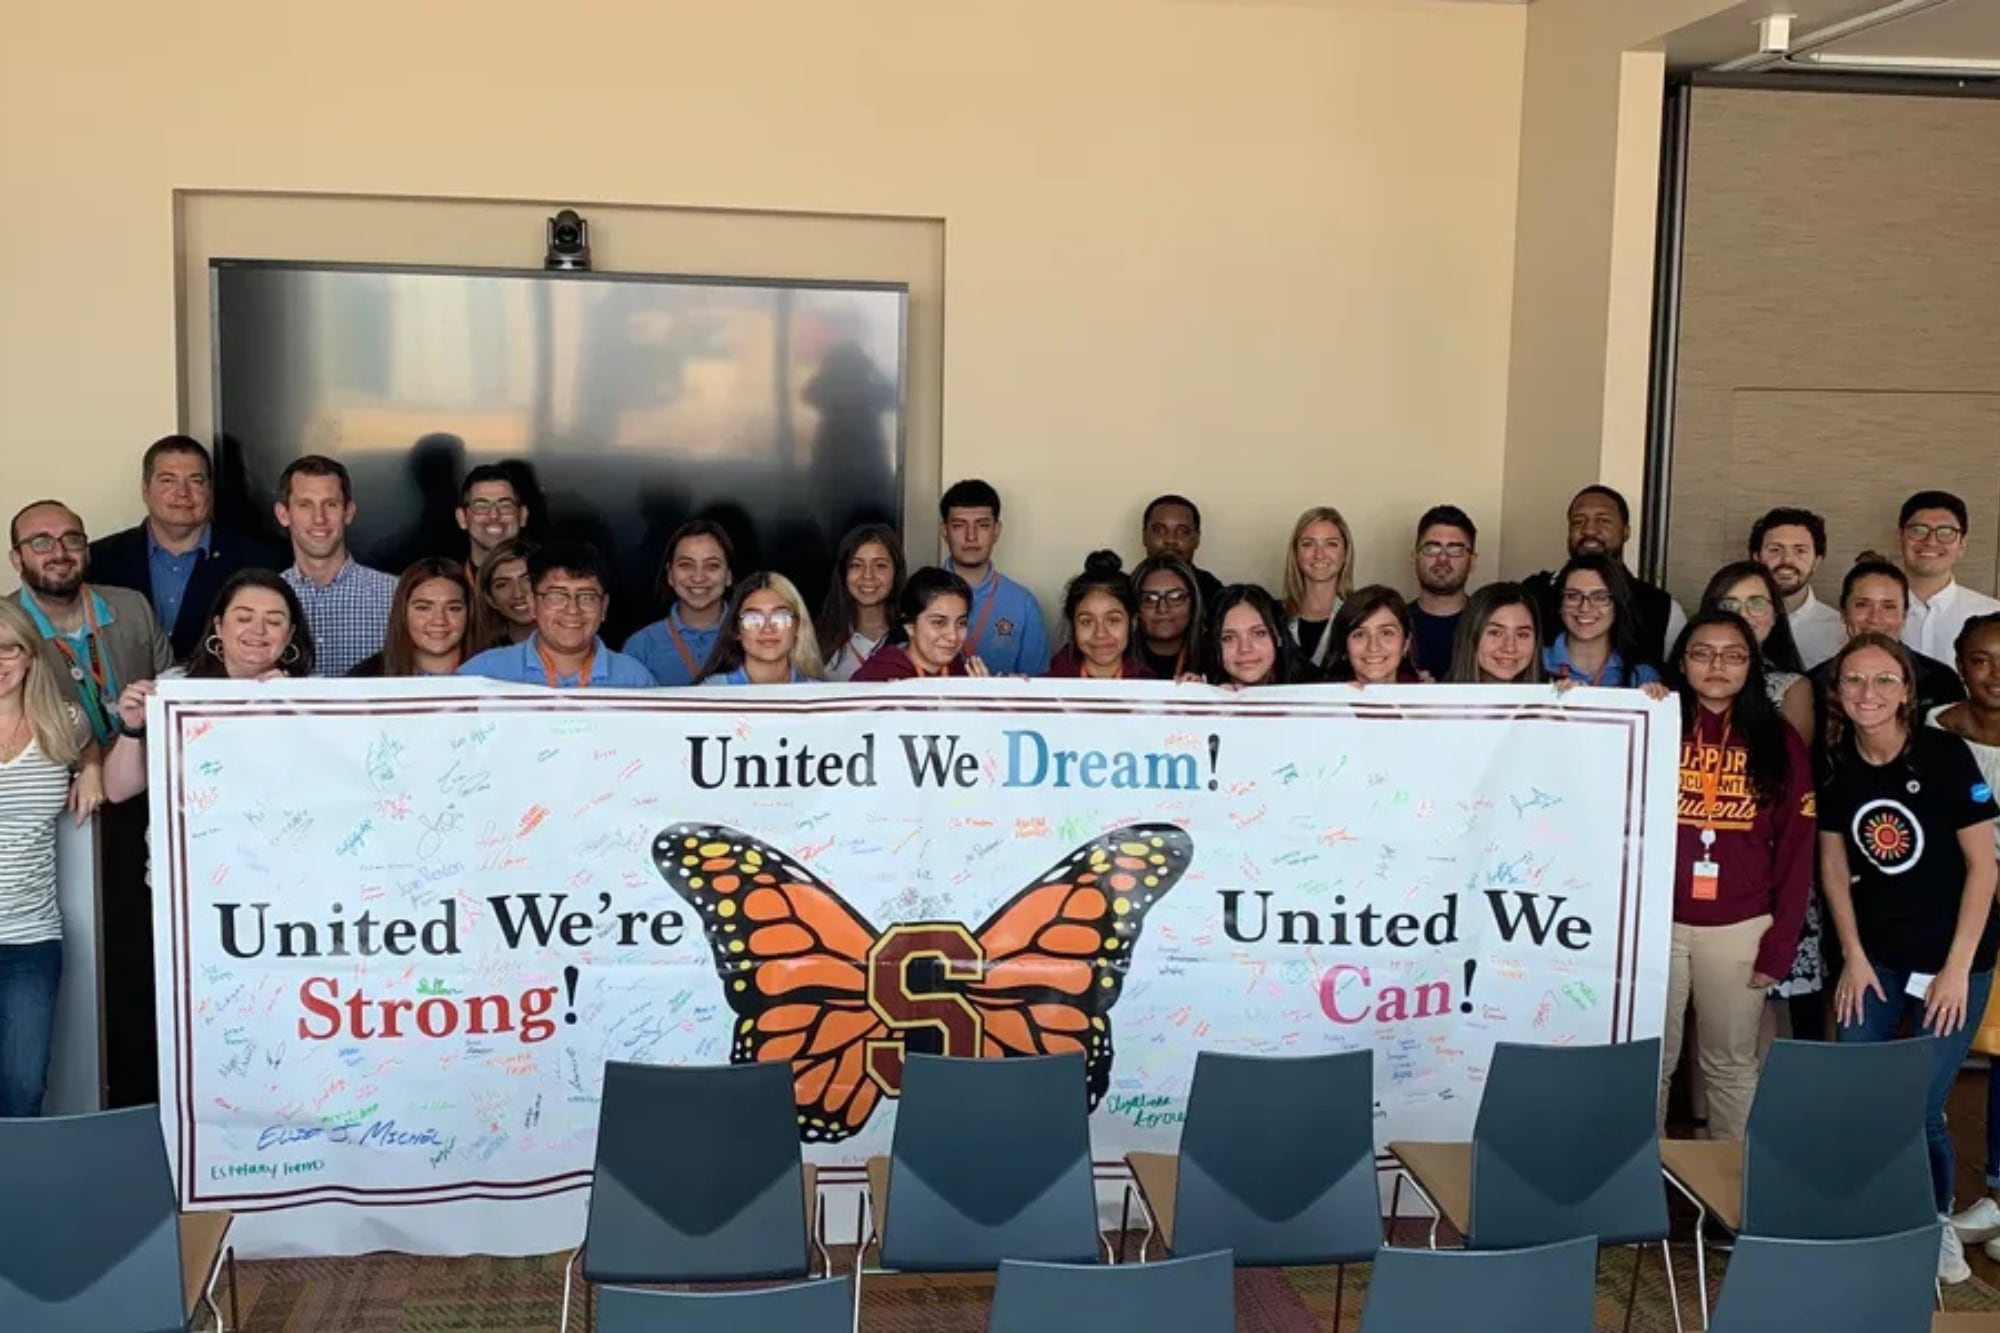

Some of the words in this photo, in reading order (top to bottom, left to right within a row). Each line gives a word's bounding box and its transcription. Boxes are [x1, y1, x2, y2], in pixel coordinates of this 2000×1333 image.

[686, 734, 878, 789] United
[898, 735, 980, 789] We
[1001, 729, 1221, 791] Dream!
[213, 899, 462, 959] United
[487, 891, 684, 949] We're
[1217, 890, 1460, 947] United
[1484, 890, 1593, 950] We
[298, 965, 580, 1044] Strong!
[863, 921, 987, 1099] S
[1319, 958, 1478, 1025] Can!
